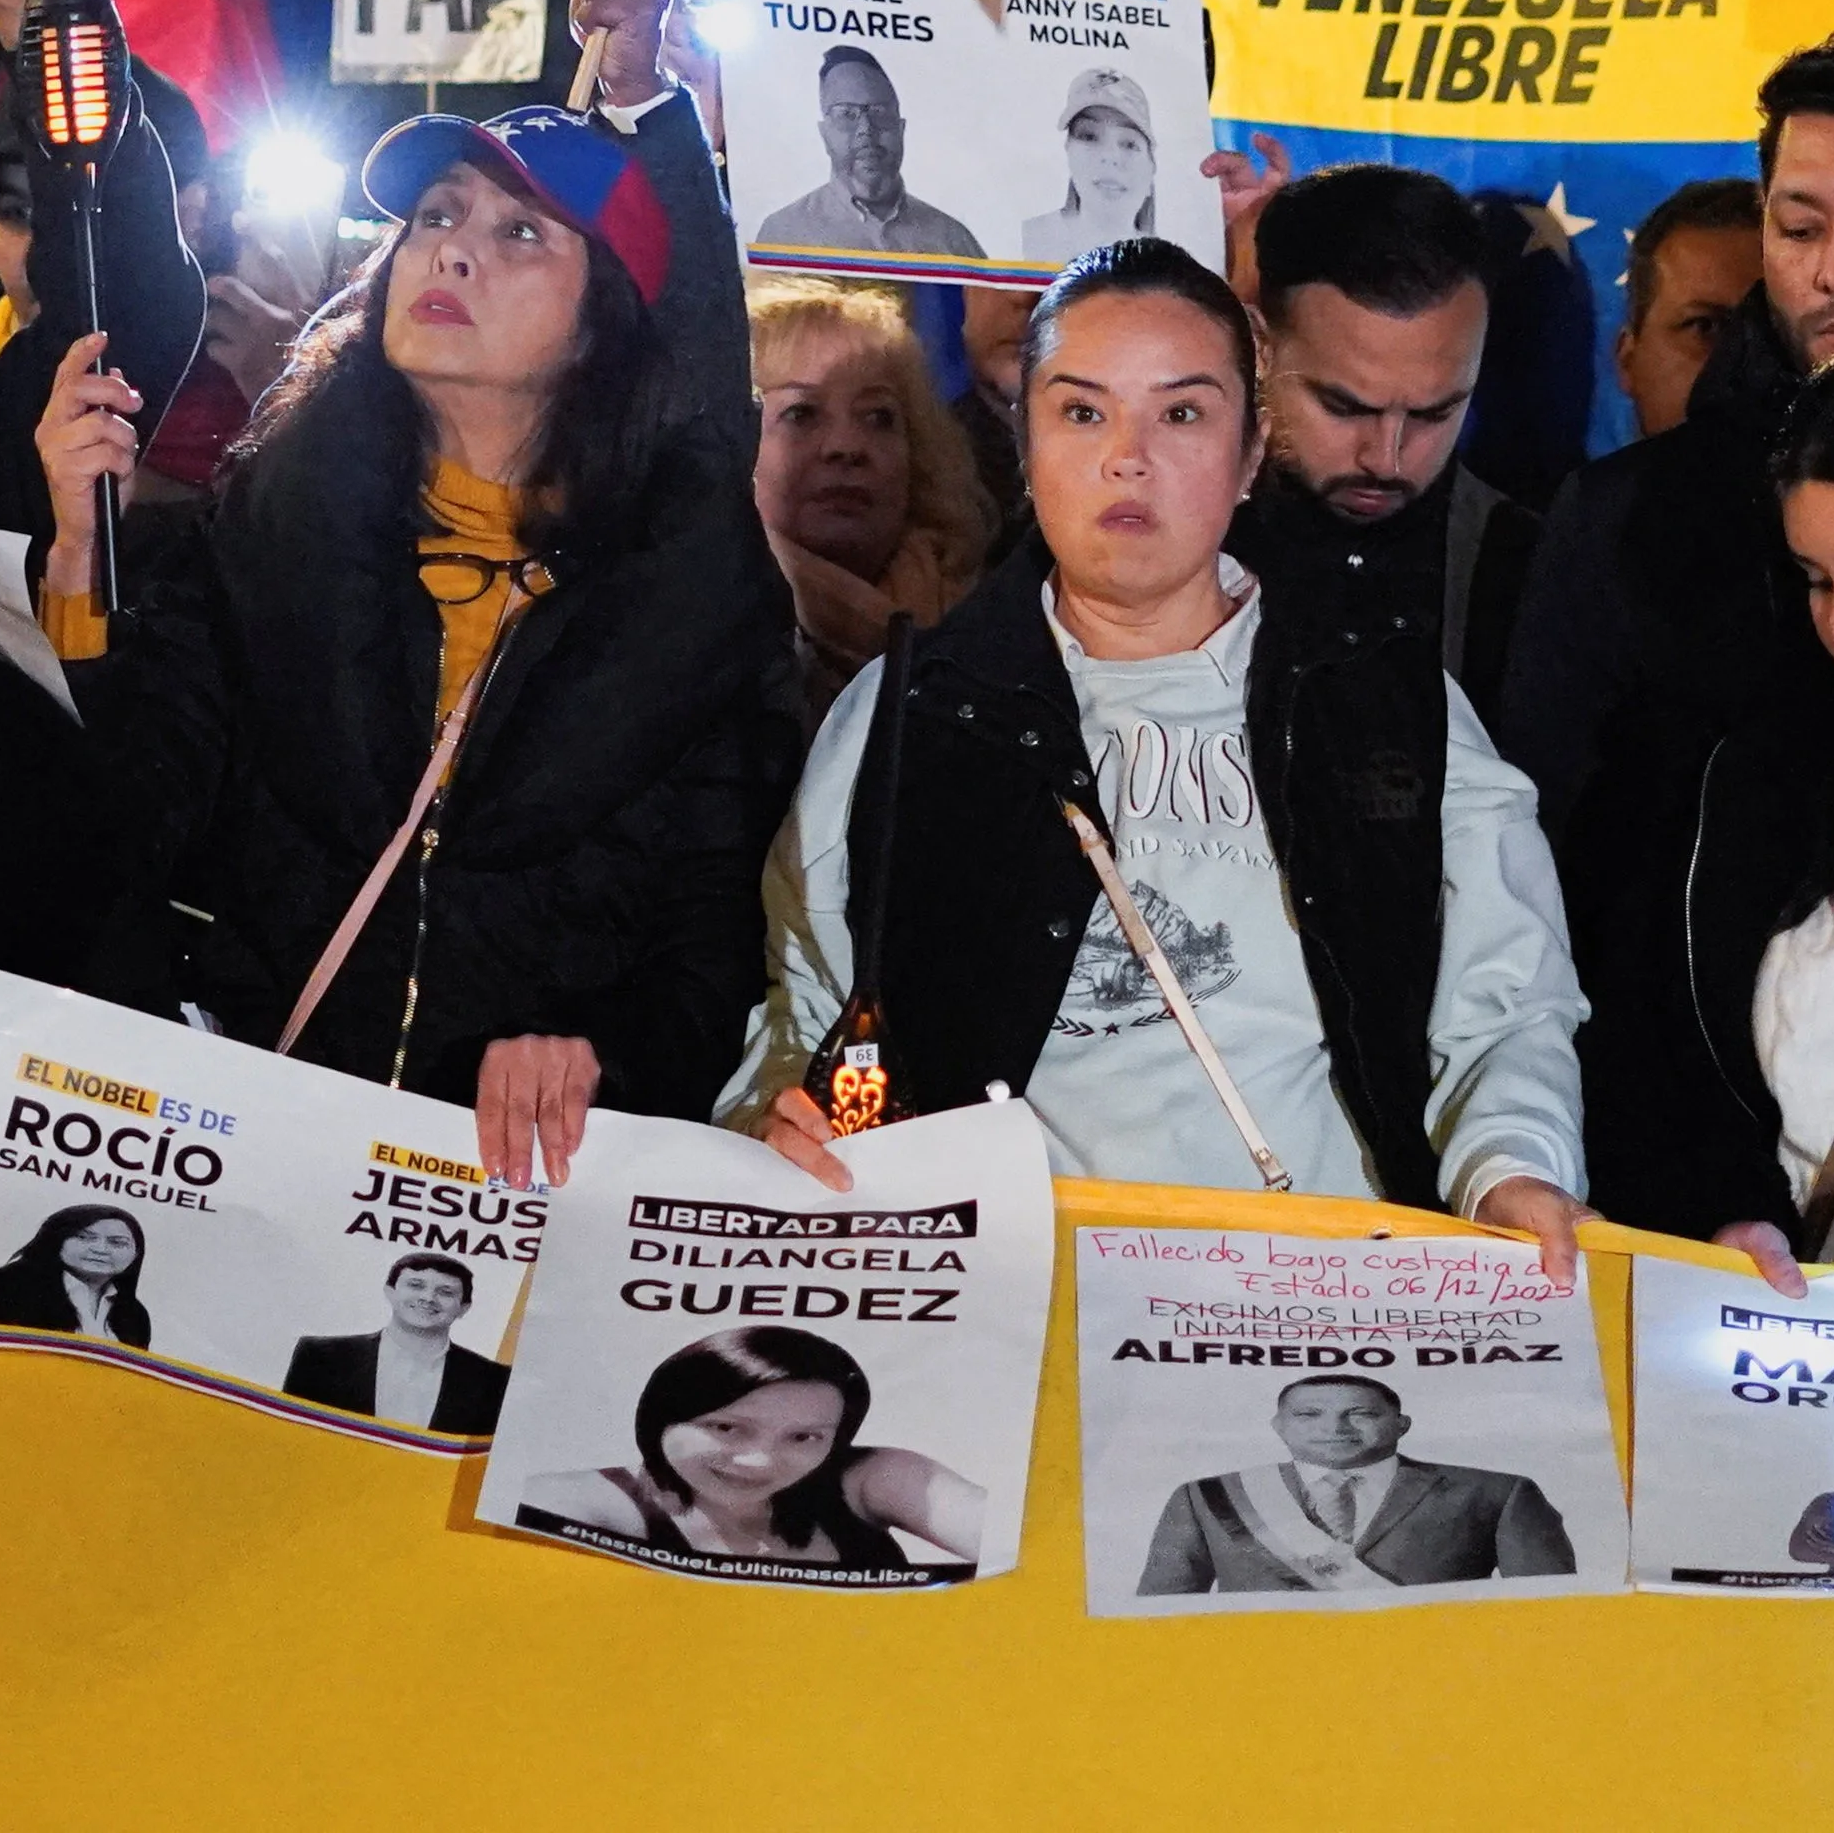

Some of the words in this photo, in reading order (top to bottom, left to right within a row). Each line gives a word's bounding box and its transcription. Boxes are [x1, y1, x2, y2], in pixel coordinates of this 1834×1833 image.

[763, 0, 934, 42] TUDARES
[1084, 2, 1171, 29] ISABEL
[1030, 23, 1130, 51] MOLINA
[1364, 22, 1612, 106] LIBRE
[23, 1057, 54, 1085] EL
[62, 1068, 151, 1114] NOBEL
[159, 1097, 192, 1124] ES
[199, 1109, 238, 1136] DE
[4, 1095, 223, 1187] ROCÍO
[375, 1143, 401, 1166] EL
[407, 1151, 481, 1184] NOBEL
[81, 1168, 218, 1213] MIGUEL
[351, 1168, 549, 1229] JESÚS
[345, 1210, 542, 1263] ARMAS
[632, 1201, 839, 1236] LIBERTAD
[849, 1210, 964, 1236] PARA
[628, 1238, 967, 1273] DILIANGELA
[1090, 1230, 1244, 1264] Fallecido
[1267, 1237, 1347, 1282] bajo
[1363, 1249, 1513, 1278] custodia
[619, 1278, 962, 1323] GUEDEZ
[1235, 1270, 1372, 1301] Estado
[1149, 1297, 1338, 1325] EXIGIMOS
[1352, 1307, 1543, 1327] LIBERTAD
[1174, 1319, 1385, 1342] INMEDIATA
[1407, 1326, 1519, 1343] PARA
[1110, 1337, 1396, 1368] ALFREDO
[1415, 1338, 1564, 1367] DÍAZ
